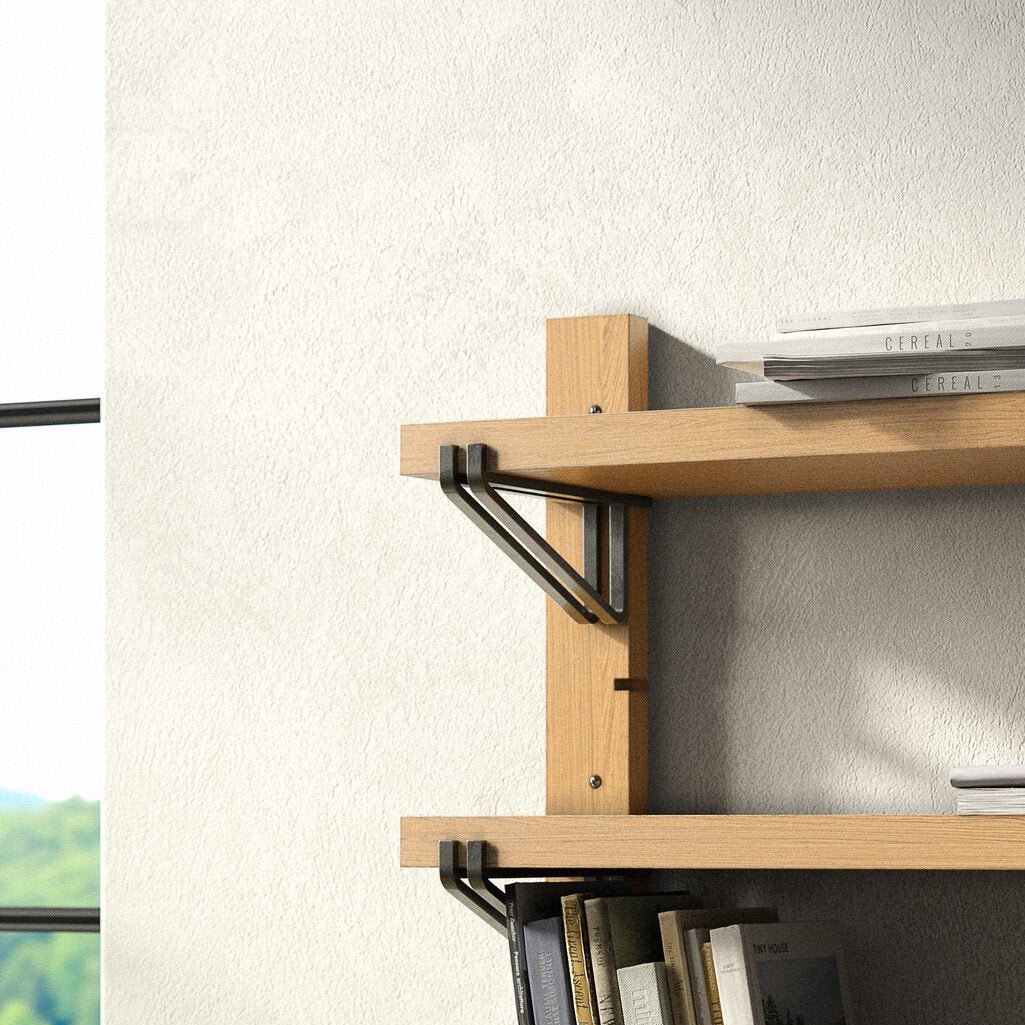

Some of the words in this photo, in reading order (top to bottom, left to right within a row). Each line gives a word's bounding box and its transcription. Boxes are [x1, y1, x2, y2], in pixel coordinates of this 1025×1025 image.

[884, 333, 956, 352] CEREAL
[911, 375, 984, 393] CEREAL
[564, 904, 579, 925] The
[752, 943, 767, 955] TINY
[767, 942, 790, 954] HOUSE
[538, 952, 549, 988] TERVER
[545, 952, 560, 1005] SIMONNET
[571, 969, 588, 1010] Ascent
